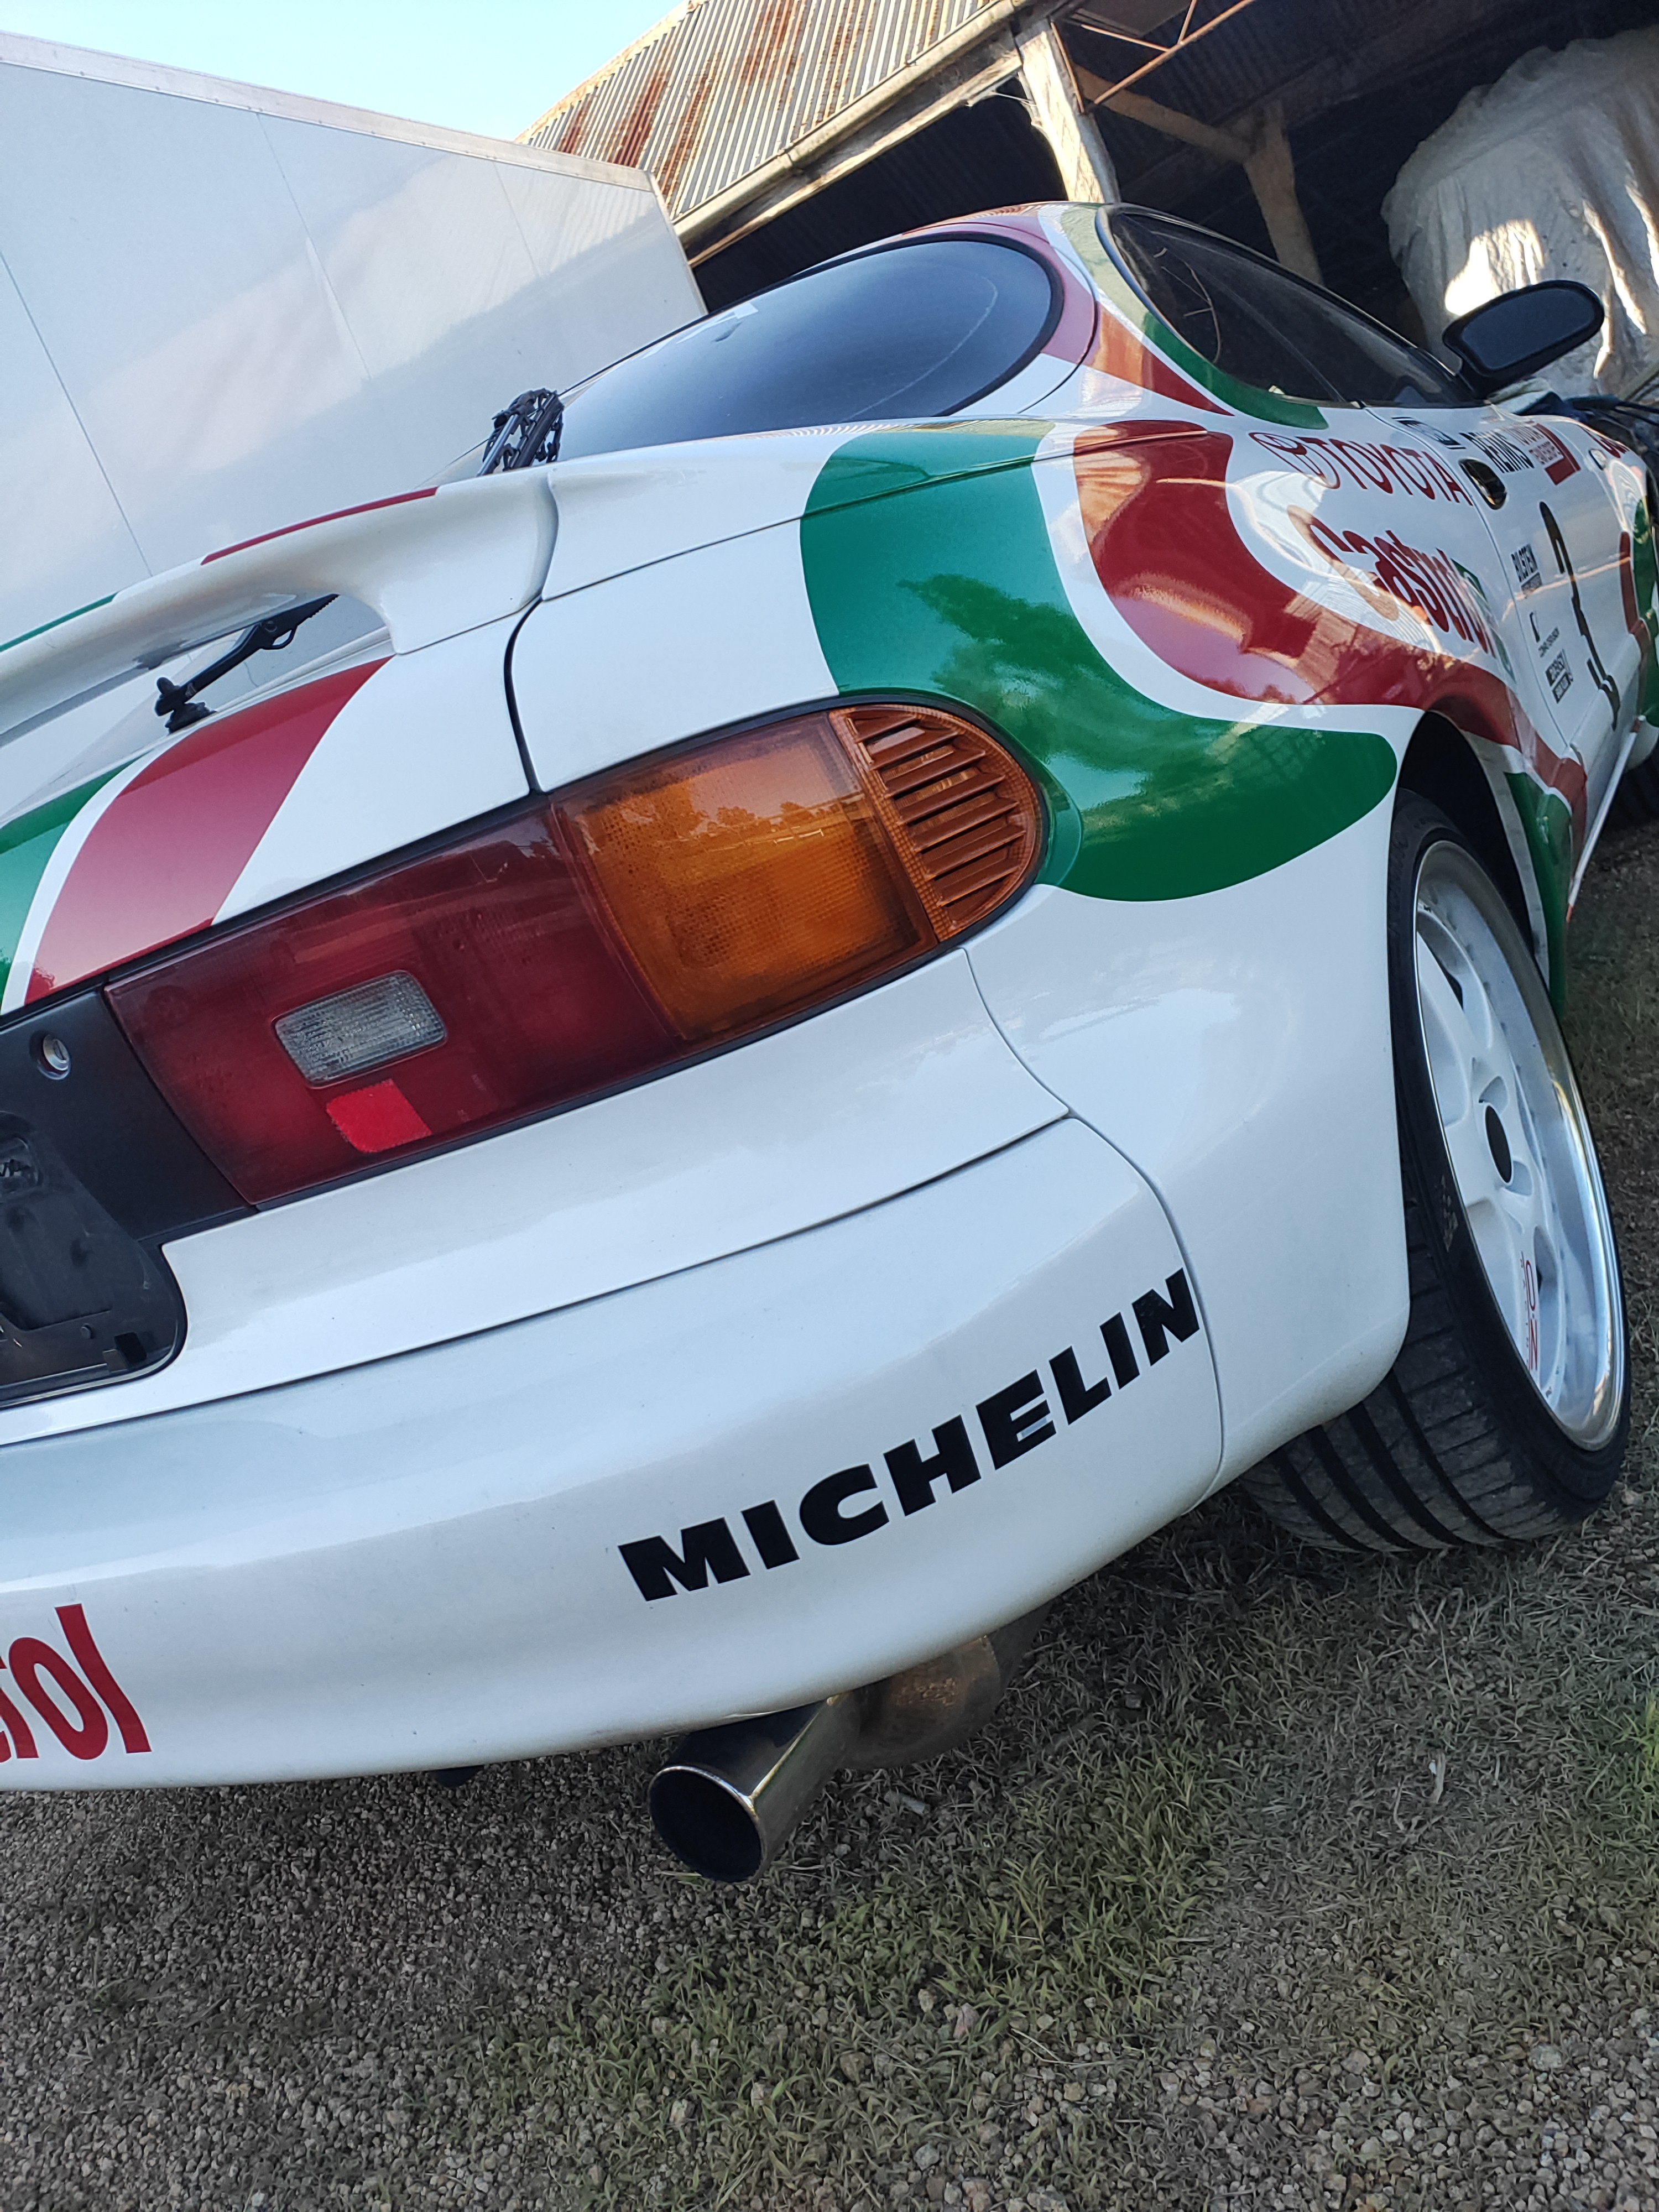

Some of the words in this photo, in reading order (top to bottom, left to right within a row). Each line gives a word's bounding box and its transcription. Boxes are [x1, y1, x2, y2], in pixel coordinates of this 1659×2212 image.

[1295, 436, 1474, 506] TOYOTA
[1287, 504, 1496, 659] Castrol
[618, 1267, 1201, 1601] MICHELIN
